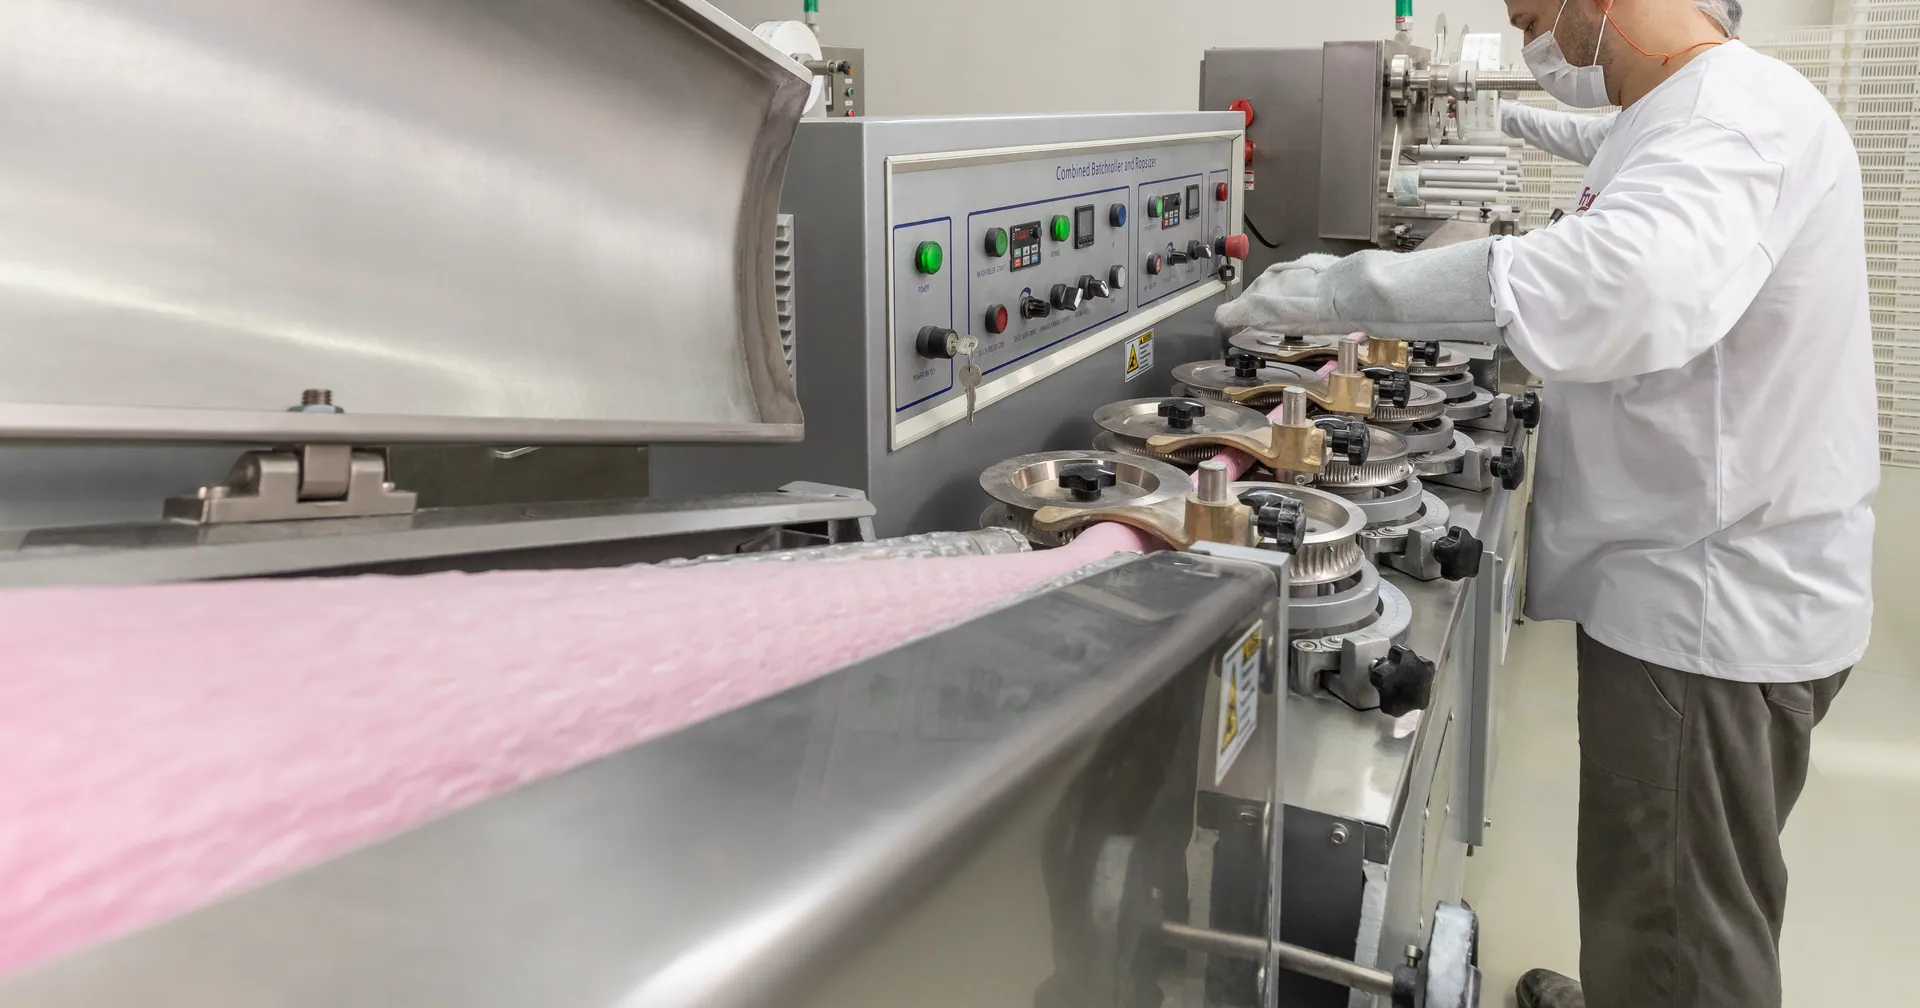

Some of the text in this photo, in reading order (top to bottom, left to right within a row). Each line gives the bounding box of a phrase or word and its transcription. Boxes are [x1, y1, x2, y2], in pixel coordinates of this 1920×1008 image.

[1056, 161, 1090, 180] Combined
[1091, 159, 1123, 176] Batchroller
[1124, 157, 1134, 171] and
[918, 283, 930, 294] POWER
